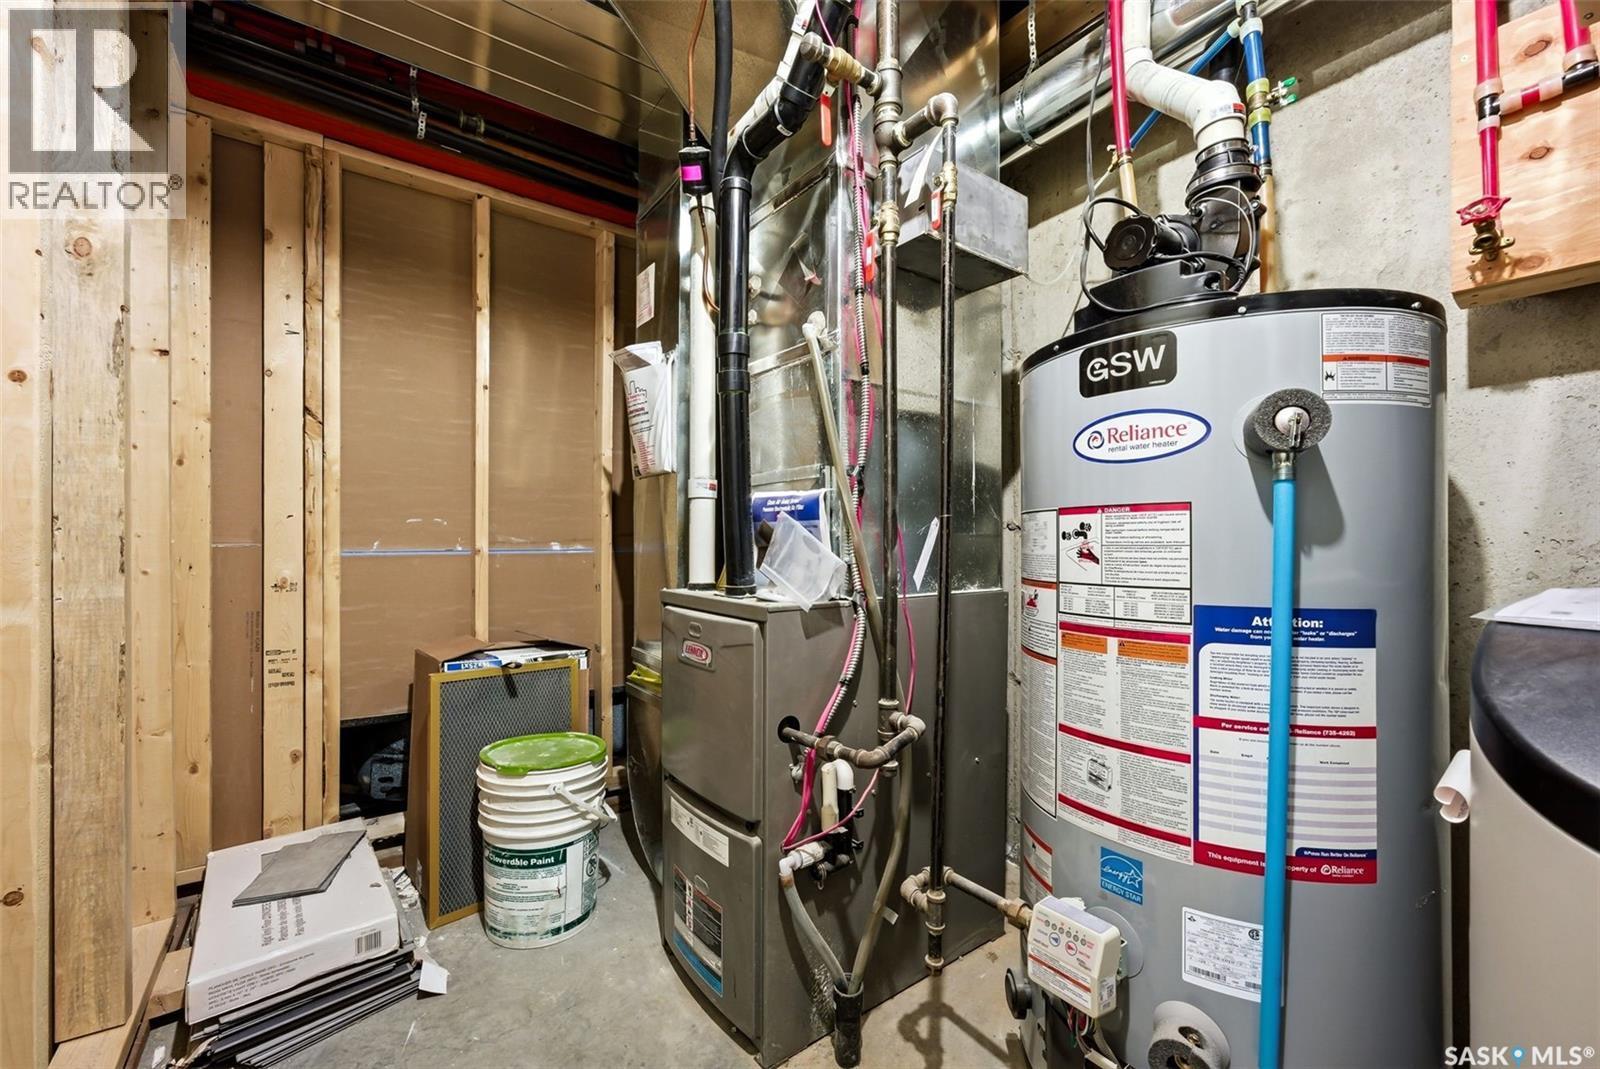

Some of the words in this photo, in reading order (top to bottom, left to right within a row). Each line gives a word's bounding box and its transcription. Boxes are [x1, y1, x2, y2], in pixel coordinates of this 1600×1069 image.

[1086, 344, 1166, 382] GSW
[1107, 423, 1188, 444] Reliance
[1107, 444, 1128, 453] rental
[1129, 442, 1150, 451] water
[1152, 439, 1178, 449] heater
[1252, 615, 1324, 628] Atttion:
[1233, 724, 1258, 732] service
[530, 856, 555, 866] Paint
[1207, 851, 1222, 860] This
[1223, 855, 1258, 866] equipment
[1331, 864, 1364, 875] Reliance
[1101, 880, 1125, 895] ENERGY
[1125, 892, 1142, 903] STAR
